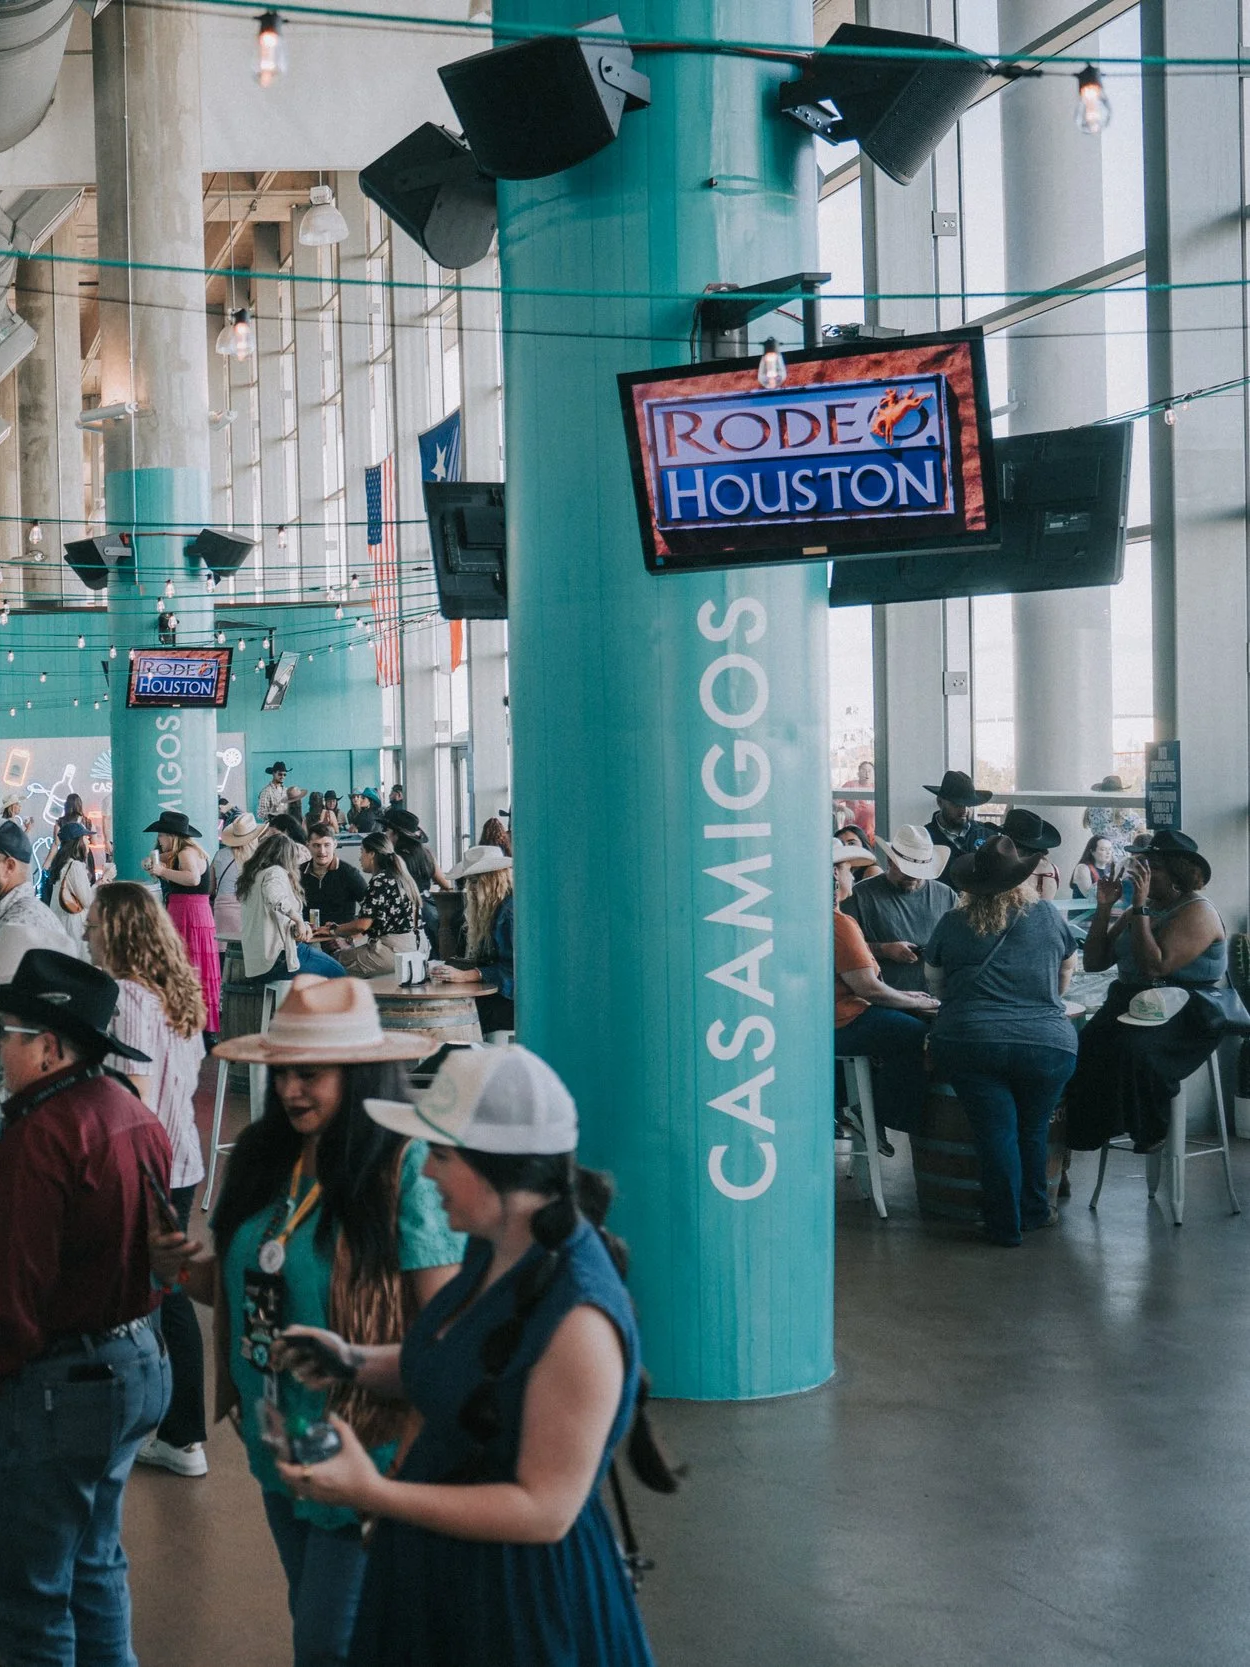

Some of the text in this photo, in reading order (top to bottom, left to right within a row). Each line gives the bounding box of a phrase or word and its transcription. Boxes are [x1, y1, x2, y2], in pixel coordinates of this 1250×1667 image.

[660, 396, 931, 458] RODEO
[667, 460, 938, 519] HOUSTON
[138, 677, 213, 695] HOUSTON
[143, 660, 213, 678] RODEO
[696, 597, 778, 1201] CASAMIGOS
